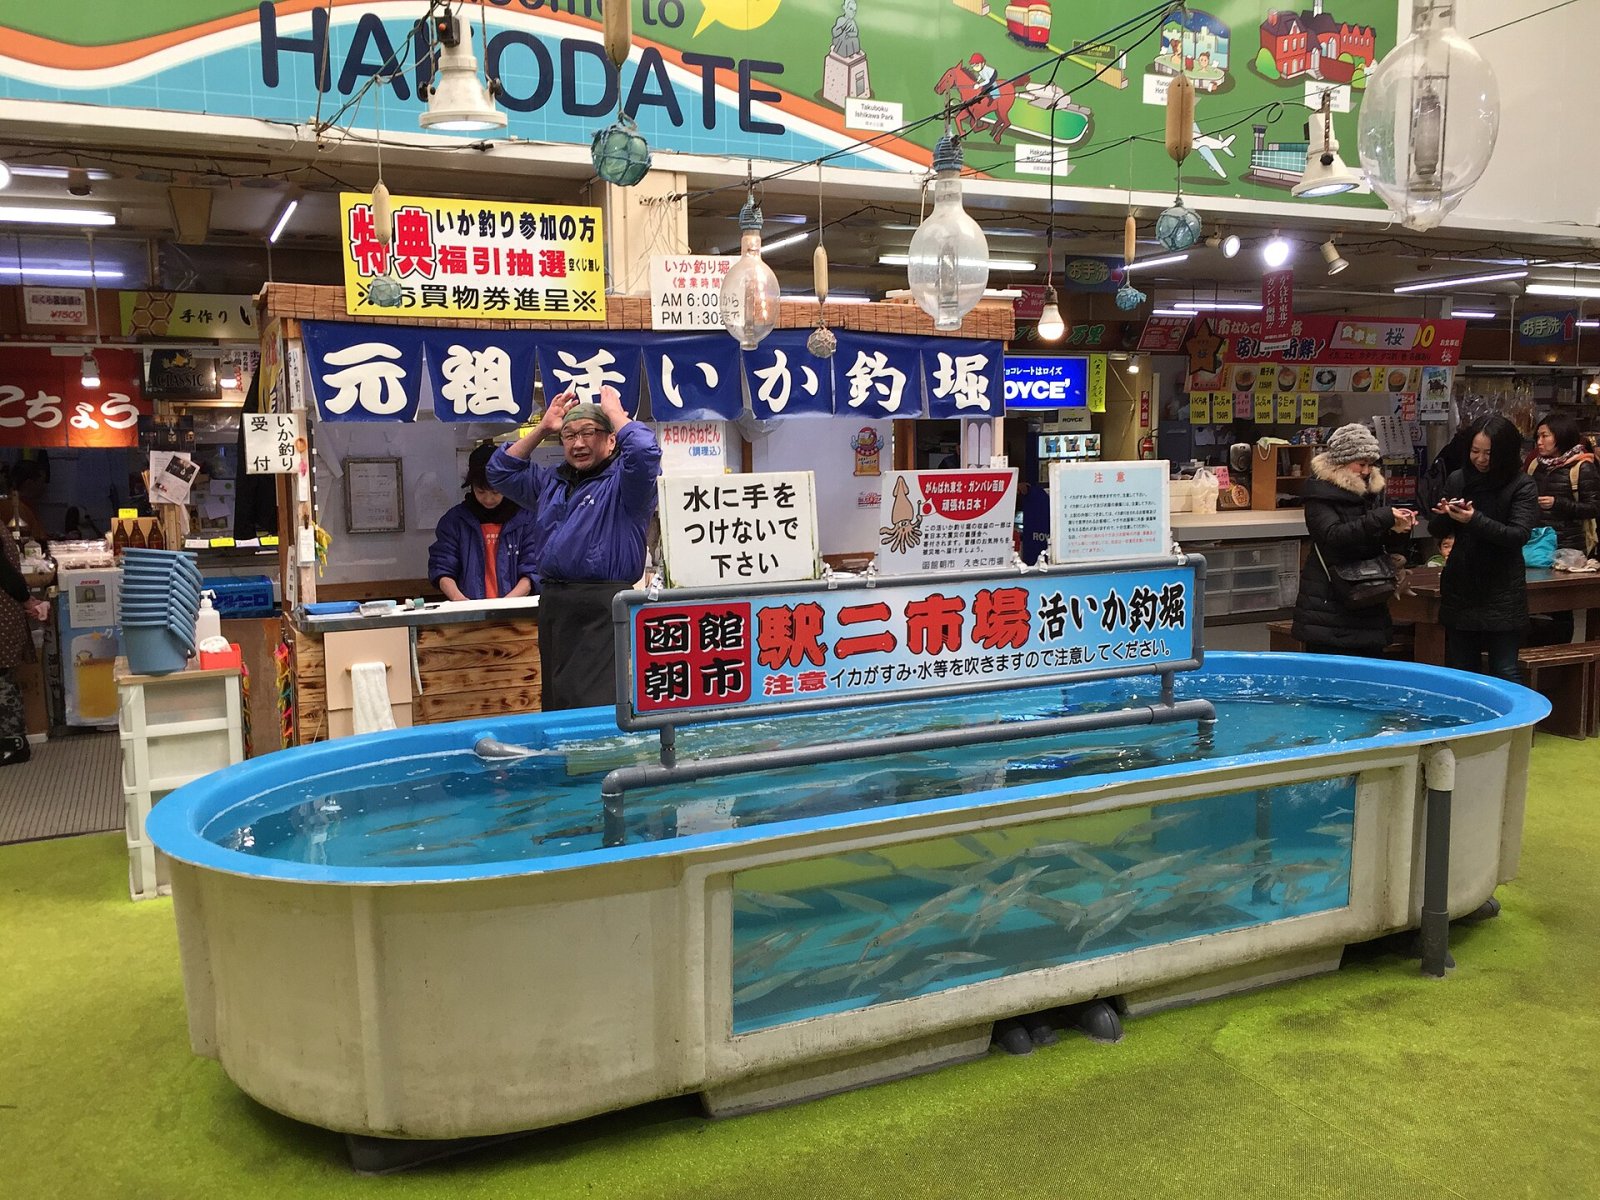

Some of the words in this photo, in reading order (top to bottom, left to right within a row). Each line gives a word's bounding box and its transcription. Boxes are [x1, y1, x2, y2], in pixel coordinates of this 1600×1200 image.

[350, 204, 437, 280] 特典
[436, 209, 596, 243] いか釣り参加の方
[438, 244, 568, 278] 福引抽選
[568, 257, 601, 273] 空くじ無し
[664, 260, 730, 275] いか釣り堀
[1069, 262, 1108, 281] お手洗
[661, 293, 682, 307] AM
[179, 308, 229, 324] 手作り
[662, 311, 682, 325] PM
[1384, 327, 1405, 346] 桜
[1522, 317, 1562, 336] お手洗
[157, 373, 205, 387] CLASSIC
[1004, 366, 1063, 376] ョコレートはロイズ
[1004, 378, 1071, 399] OYCE'
[250, 416, 271, 472] 受付
[277, 415, 295, 472] いか釣り
[663, 424, 721, 445] 本日のおねだん
[688, 446, 722, 456] (調理込)
[924, 479, 1005, 494] がんばれ東北・ガンバレ函館
[1094, 471, 1126, 483] 注意
[683, 482, 796, 513] 水に手を
[684, 516, 798, 546] つけないで
[710, 551, 780, 580] 下さい
[921, 560, 956, 570] 函館朝市
[963, 557, 1005, 568] えきに市場
[1037, 582, 1186, 644] 活いか釣堀
[643, 609, 745, 656] 函館
[643, 657, 745, 704] 朝市
[763, 670, 828, 697] 注意
